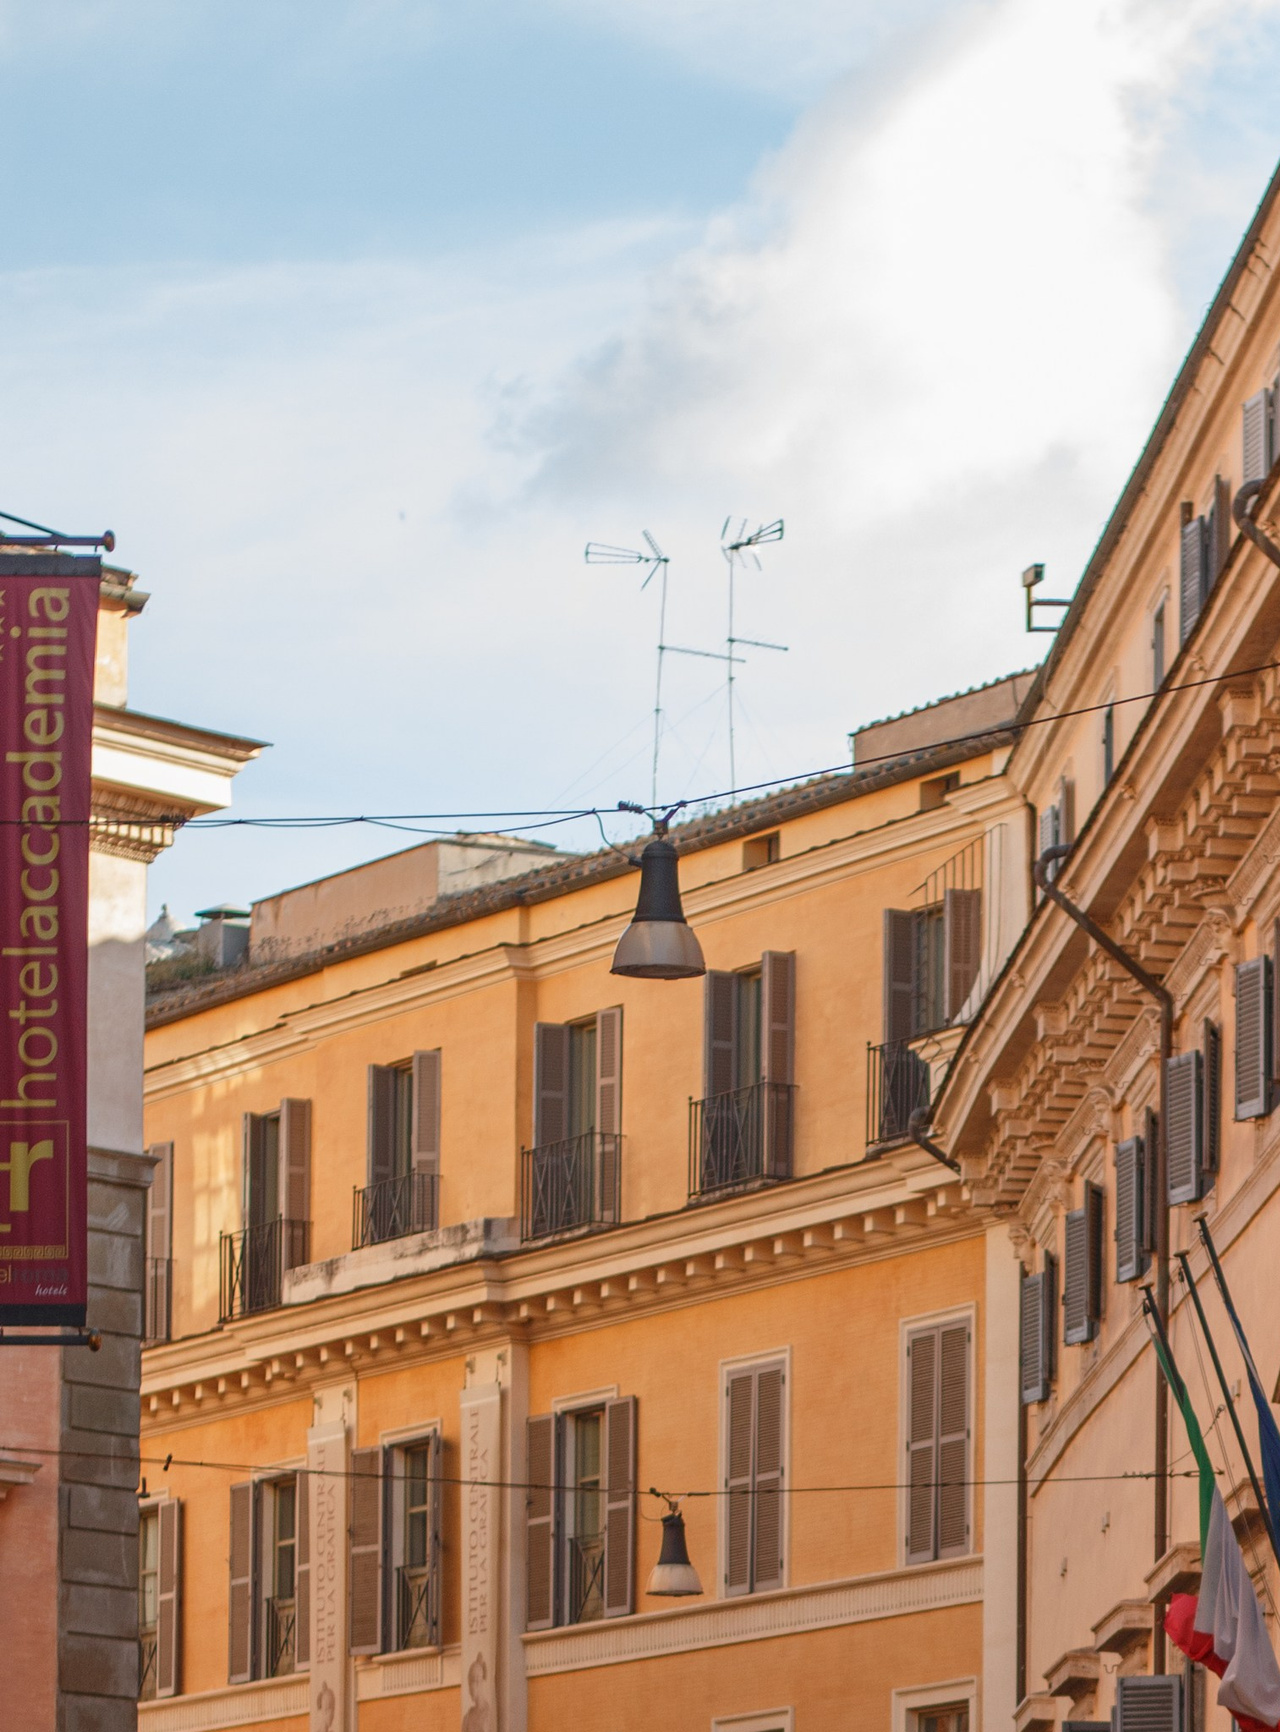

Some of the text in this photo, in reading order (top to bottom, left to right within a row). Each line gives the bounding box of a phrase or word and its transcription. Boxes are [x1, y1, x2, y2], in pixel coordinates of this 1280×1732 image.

[1, 586, 70, 1108] hotelaccademia
[35, 1283, 68, 1296] hotels
[316, 1443, 326, 1664] ISTITUTO CENTRALE
[326, 1484, 336, 1662] PER LA GRAFICA
[469, 1406, 480, 1635] ISTITUTO CENTRALE
[479, 1447, 488, 1633] PER LA GRAFCA
